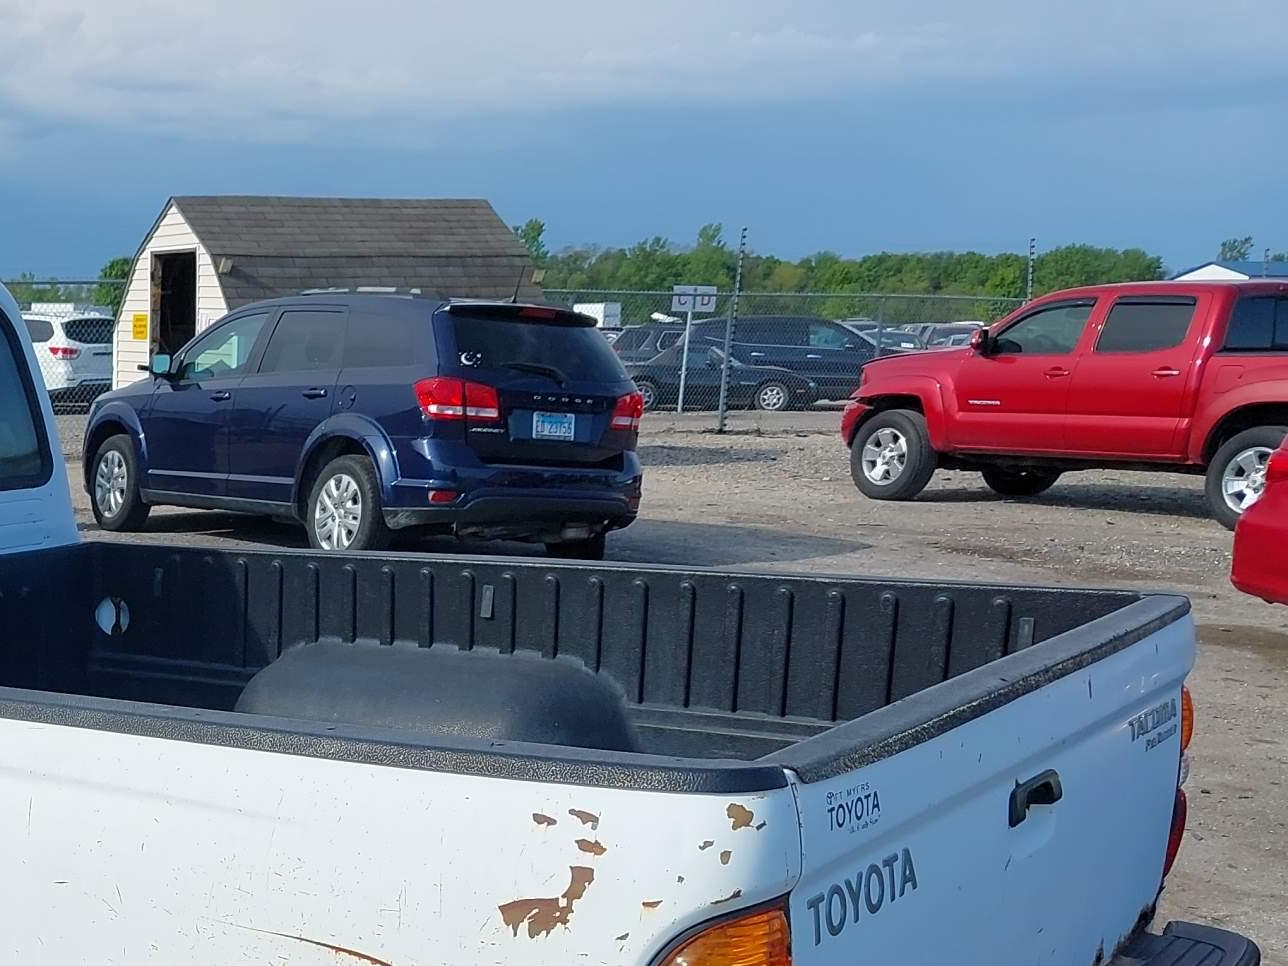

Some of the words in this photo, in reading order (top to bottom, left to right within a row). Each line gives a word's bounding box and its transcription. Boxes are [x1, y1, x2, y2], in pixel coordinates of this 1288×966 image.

[1128, 698, 1177, 742] TACOMA
[827, 790, 881, 832] TOYOTA
[806, 847, 918, 946] TOYOTA
